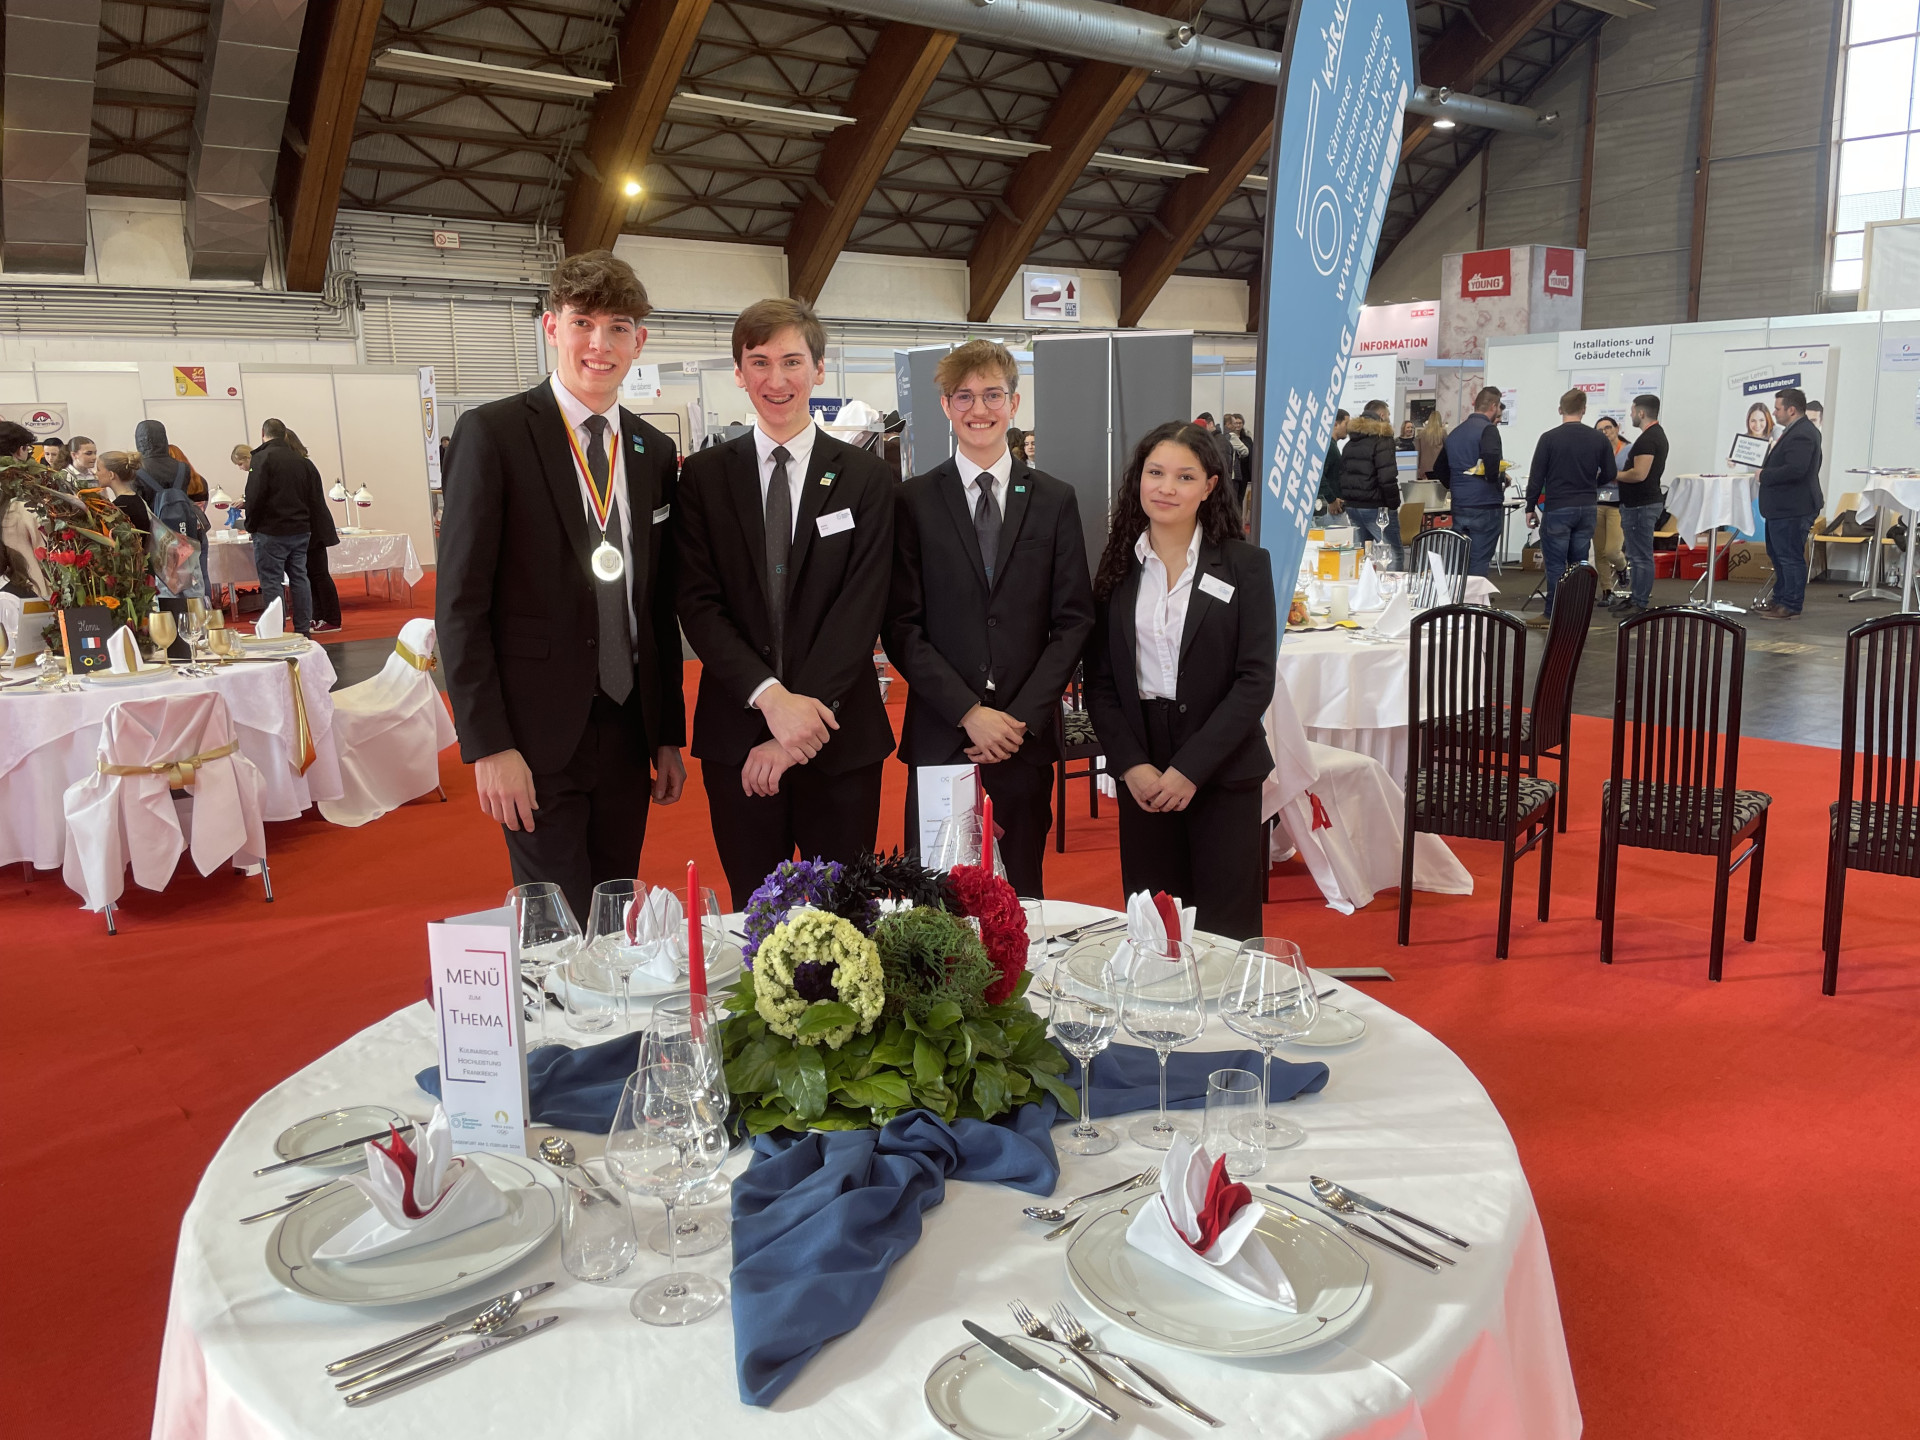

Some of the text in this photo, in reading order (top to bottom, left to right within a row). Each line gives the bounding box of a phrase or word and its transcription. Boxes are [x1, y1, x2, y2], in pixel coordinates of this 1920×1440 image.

[1336, 13, 1384, 184] Tourismusschulen
[1326, 75, 1353, 166] Kärntner
[1345, 35, 1392, 203] Warmbad Villach
[1336, 56, 1400, 301] www.kts-villach.at
[1030, 278, 1061, 315] 2
[1470, 278, 1500, 289] YOUNG
[1550, 278, 1567, 287] YOUNG
[1360, 337, 1428, 351] INFORMATION
[1573, 336, 1654, 349] Installations- und
[1574, 348, 1651, 360] Gebäudetechnik
[1759, 379, 1795, 390] Installateur
[1268, 386, 1302, 499] DEINE
[1295, 324, 1352, 538] ZUM ERFOLG
[1282, 390, 1319, 515] TREPPE
[446, 967, 500, 987] MENÜ
